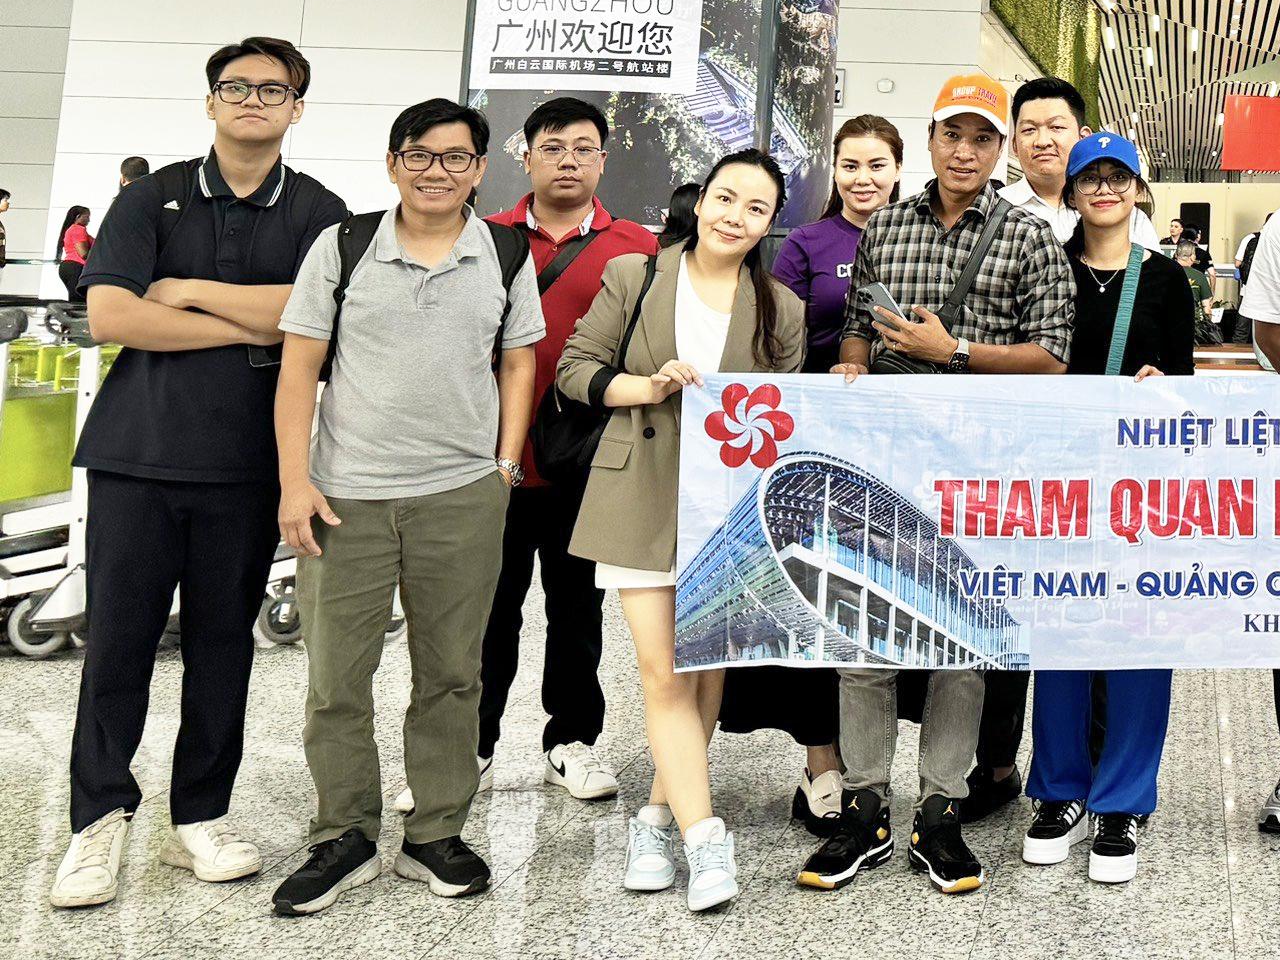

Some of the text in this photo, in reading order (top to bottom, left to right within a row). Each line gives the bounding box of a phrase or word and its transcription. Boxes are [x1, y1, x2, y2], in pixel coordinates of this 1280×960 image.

[492, 19, 674, 56] 广州欢迎您
[492, 59, 669, 74] 广州白云国际机场二号航站楼
[1097, 136, 1111, 149] P
[1117, 412, 1215, 453] NHIỆT
[932, 478, 1092, 539] THAM
[1108, 478, 1258, 547] QUAN
[961, 565, 1024, 606] VIỆT
[1033, 571, 1107, 598] NAM
[1136, 563, 1256, 598] QUẢNG
